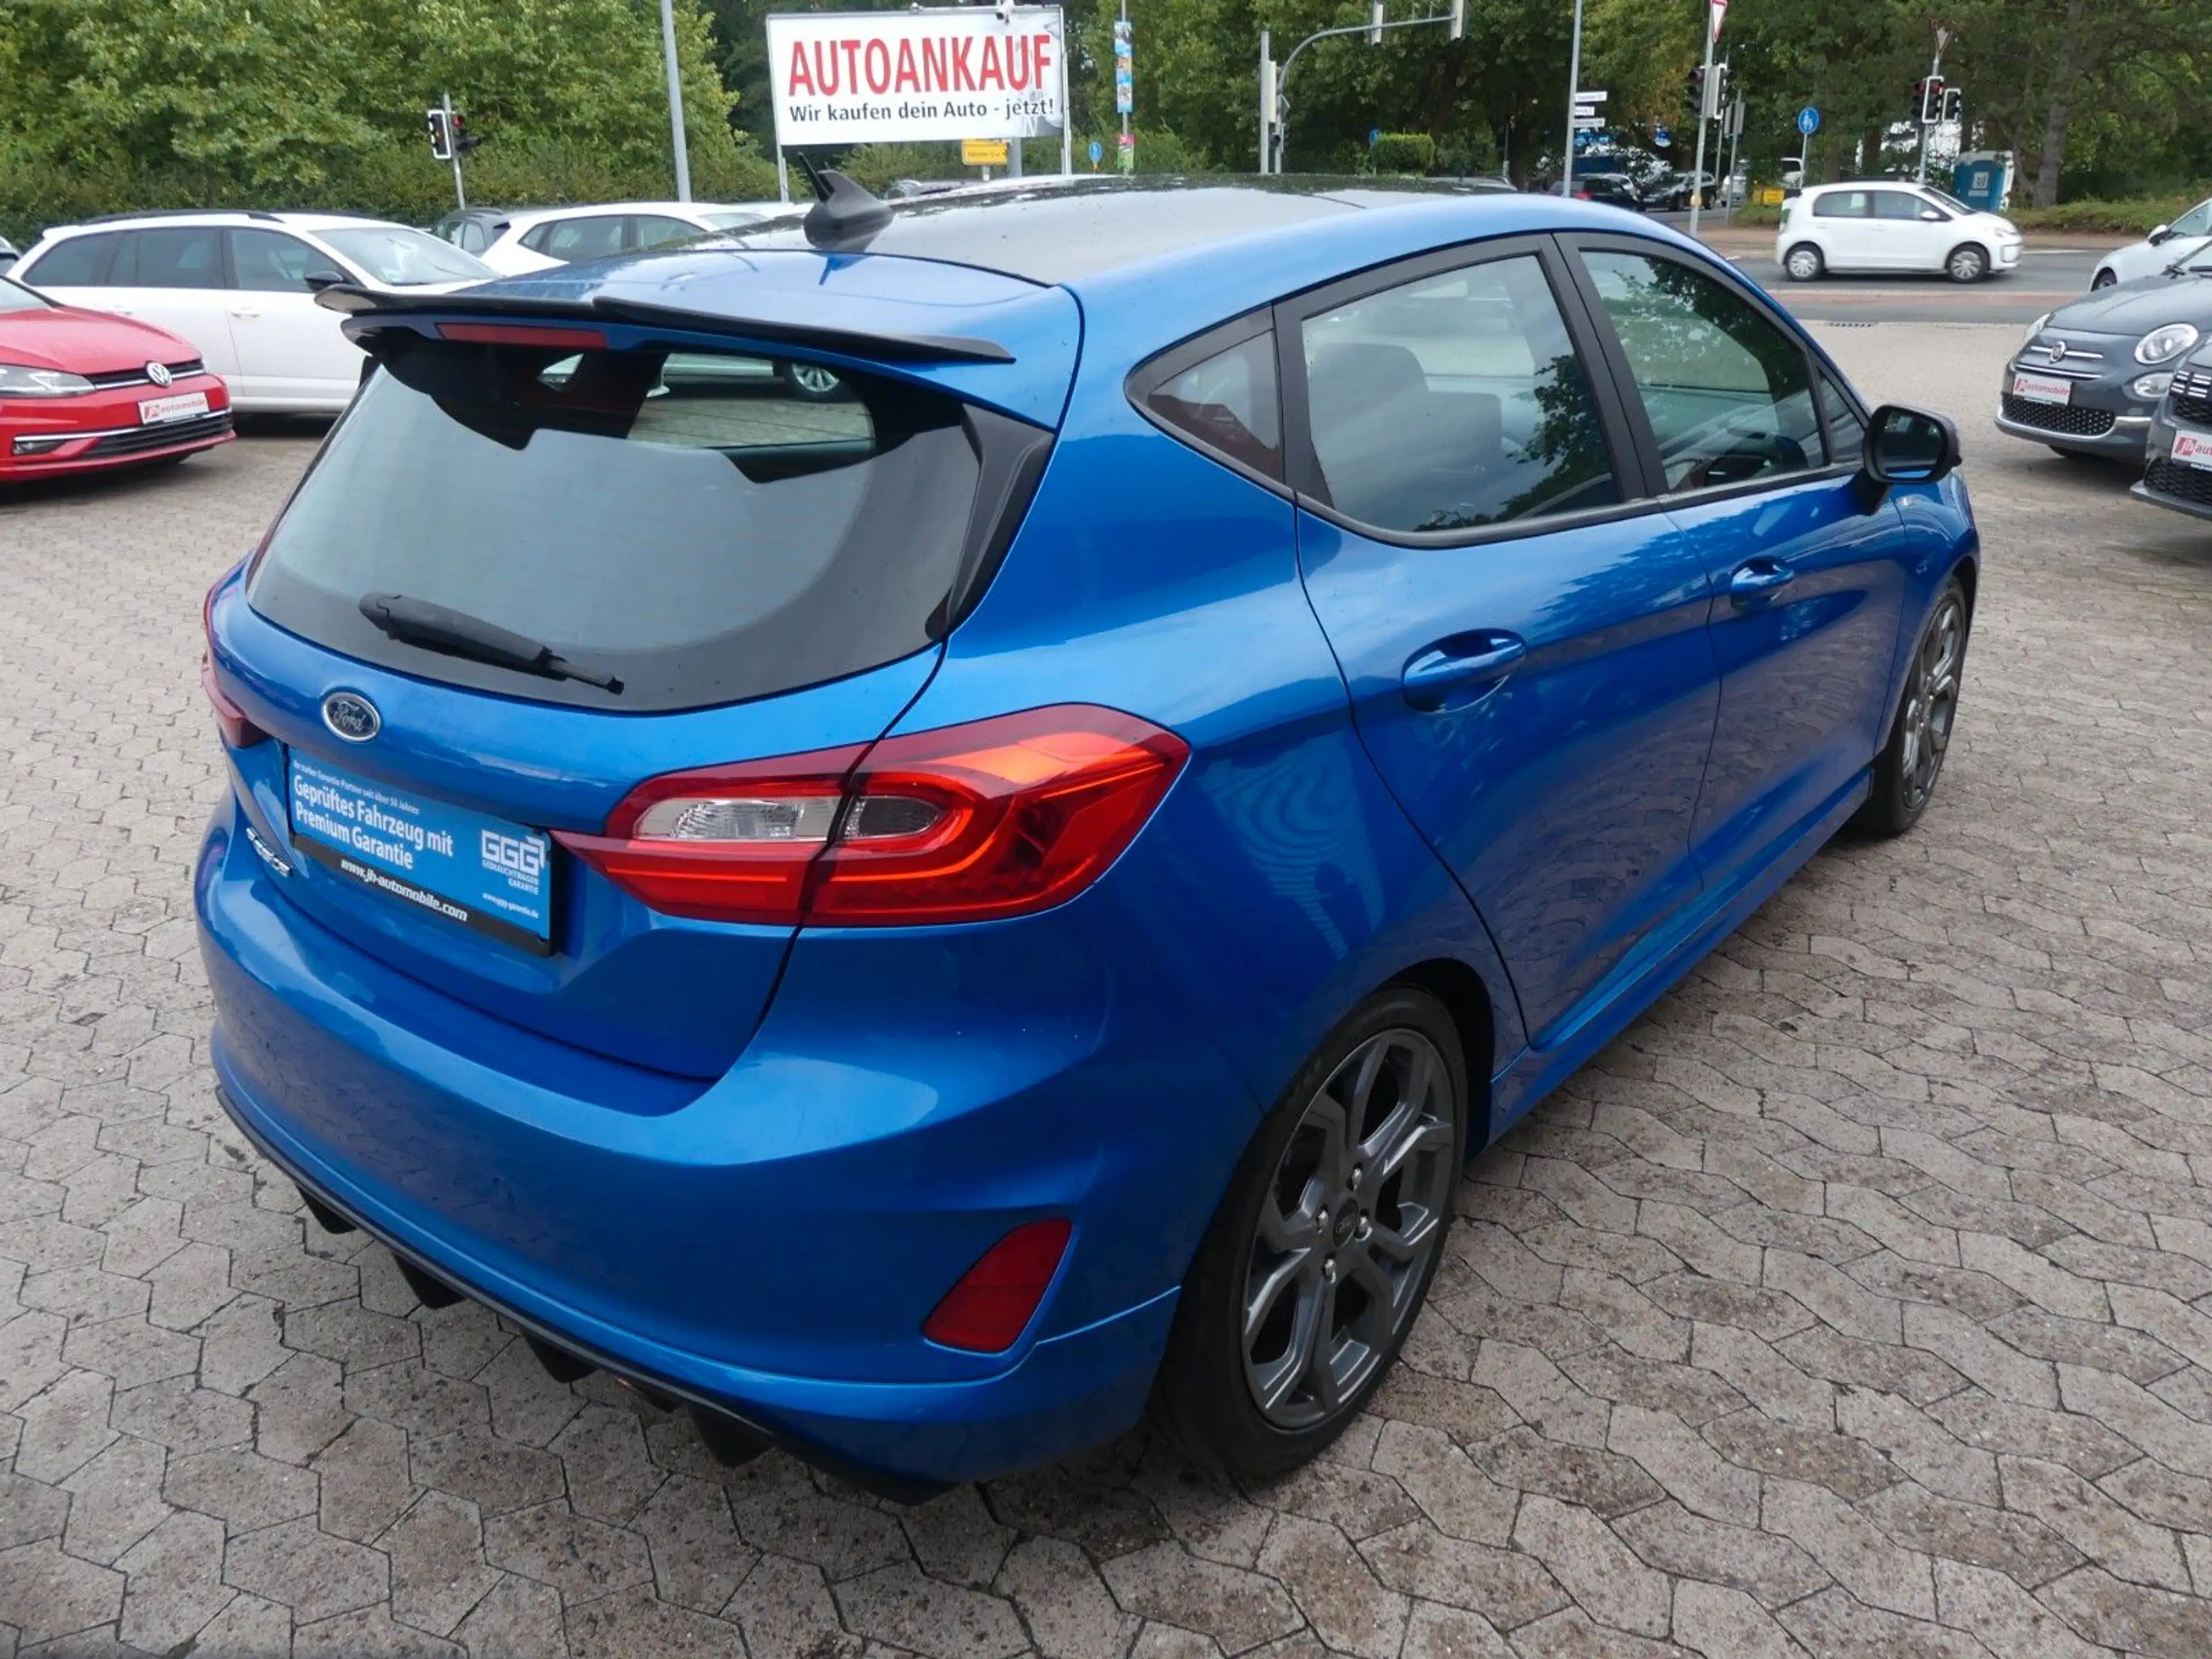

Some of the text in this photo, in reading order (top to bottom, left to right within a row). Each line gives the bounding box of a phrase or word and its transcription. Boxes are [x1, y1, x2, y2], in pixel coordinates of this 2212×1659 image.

[789, 35, 1051, 97] AUTOANKAUF
[790, 104, 821, 122] Wir
[827, 102, 892, 121] kaufen
[898, 101, 938, 119] dein
[944, 101, 987, 118] Auto
[1006, 99, 1054, 120] jetzt!
[294, 775, 453, 857] Geprüftes Fahrzeug mit
[296, 801, 414, 870] Premium Garantie
[482, 830, 540, 877] GGG
